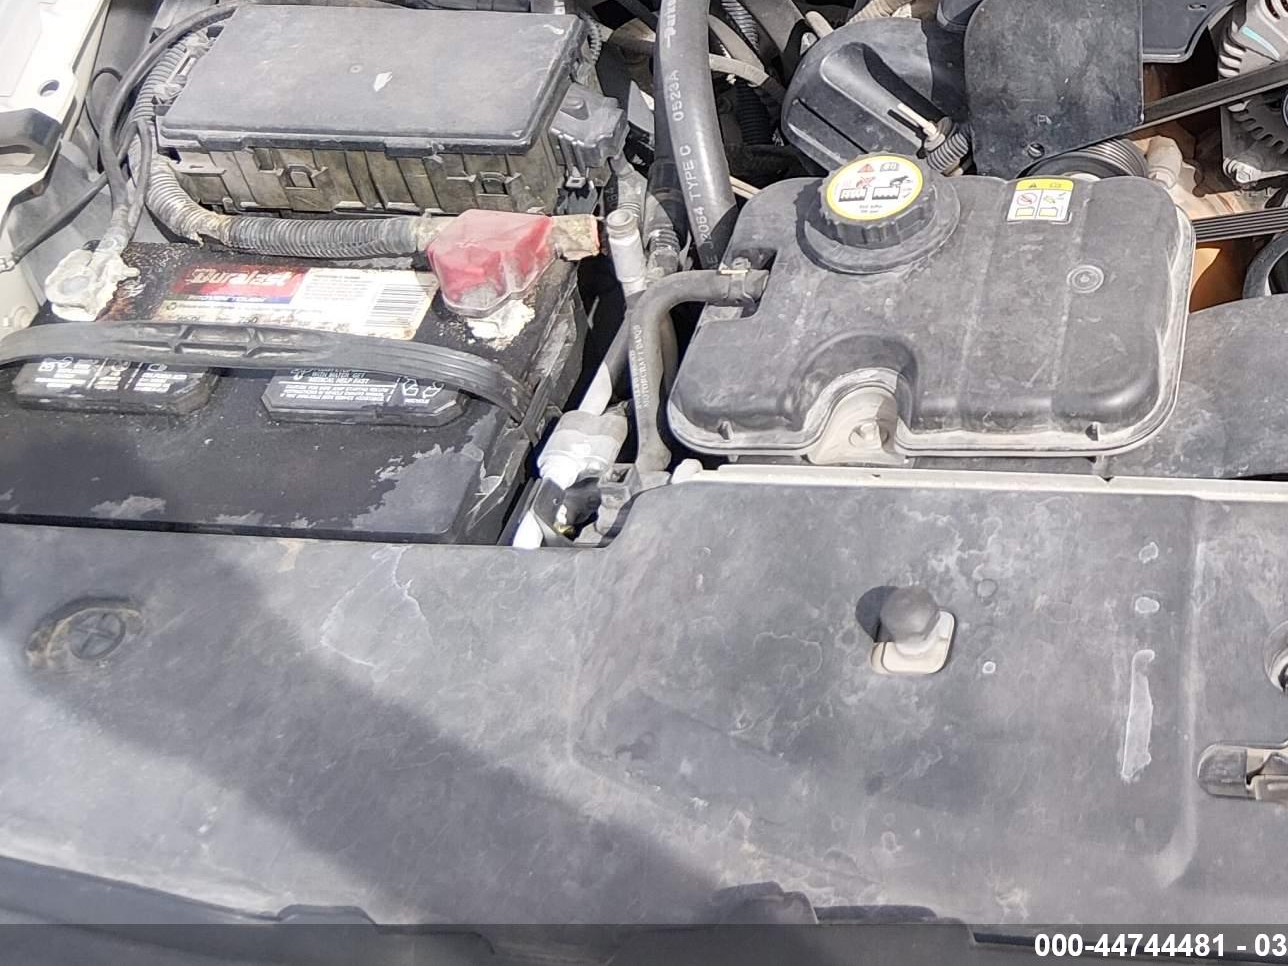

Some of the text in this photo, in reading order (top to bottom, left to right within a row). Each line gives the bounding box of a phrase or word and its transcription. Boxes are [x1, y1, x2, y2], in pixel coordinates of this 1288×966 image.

[670, 69, 684, 123] 0523A
[679, 143, 692, 157] C
[682, 159, 701, 200] TYPE
[700, 206, 715, 251] J2064
[185, 268, 293, 286] Duralast
